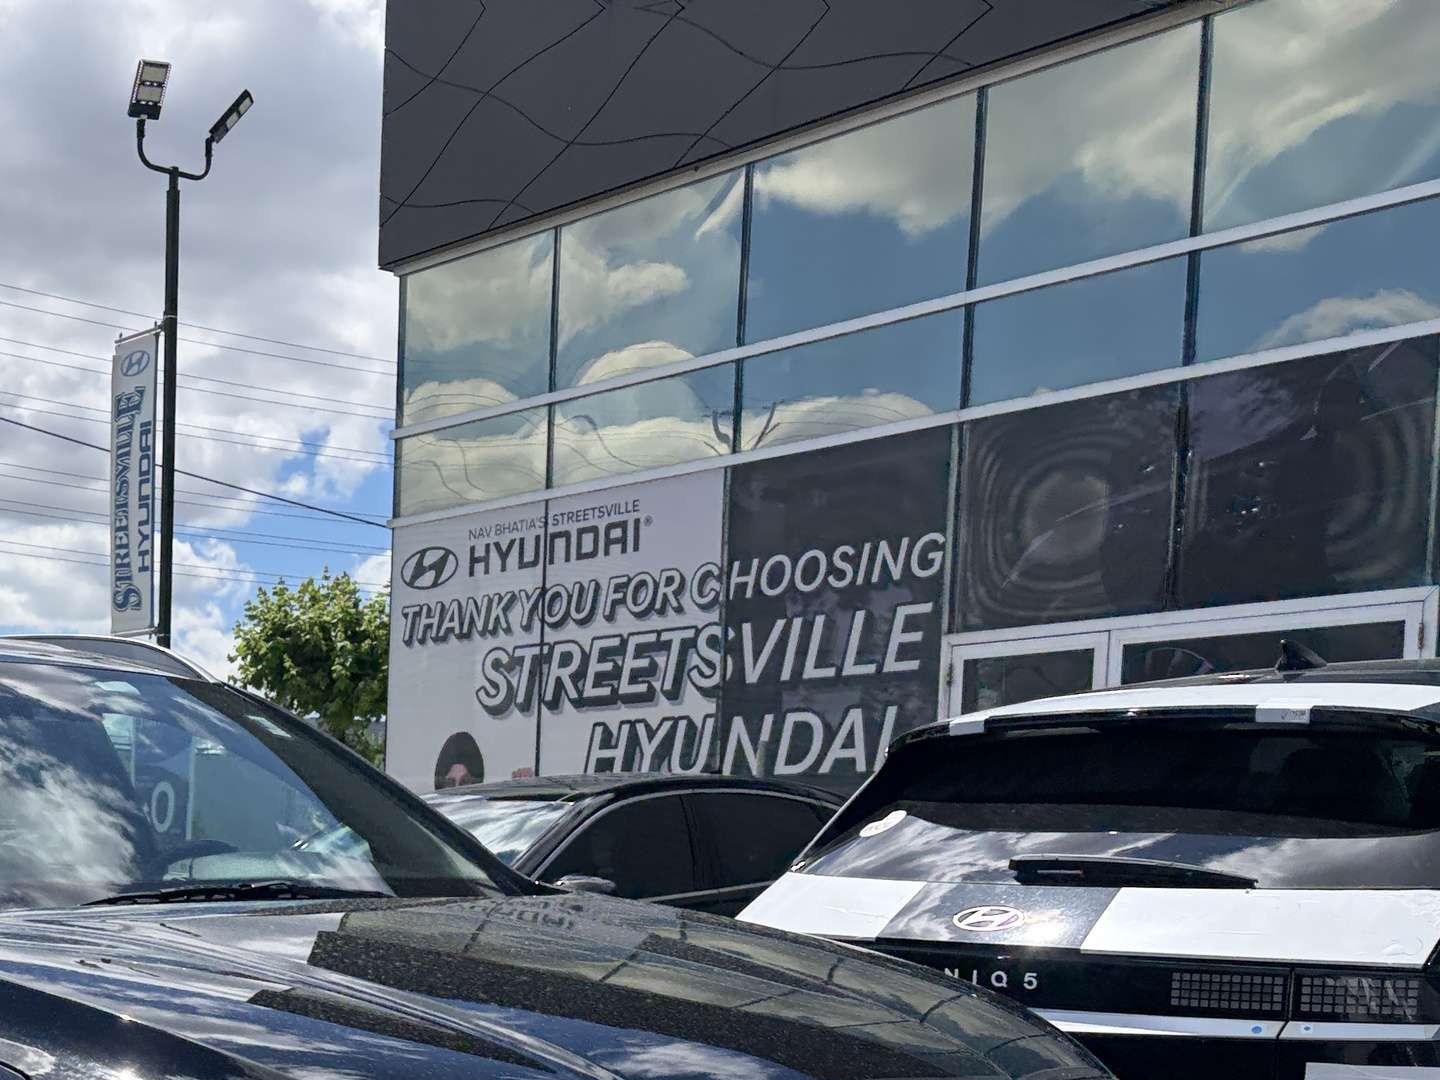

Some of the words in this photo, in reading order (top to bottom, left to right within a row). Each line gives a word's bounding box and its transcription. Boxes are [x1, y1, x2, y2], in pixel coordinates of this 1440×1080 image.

[112, 386, 145, 612] STREETSVILLE
[137, 420, 152, 573] HYUNDAI
[468, 527, 491, 541] NAV
[494, 516, 548, 536] BHATIA'S
[551, 499, 641, 526] STREETSVILLE
[401, 591, 516, 646] THANK
[519, 579, 600, 632] YOU
[603, 568, 686, 622] FOR
[691, 532, 946, 607] CHOOSING
[469, 518, 641, 577] HYUNDAI
[476, 602, 934, 715] STREETSVILLE
[584, 705, 898, 777] HYUNDAI
[1023, 972, 1038, 990] 5
